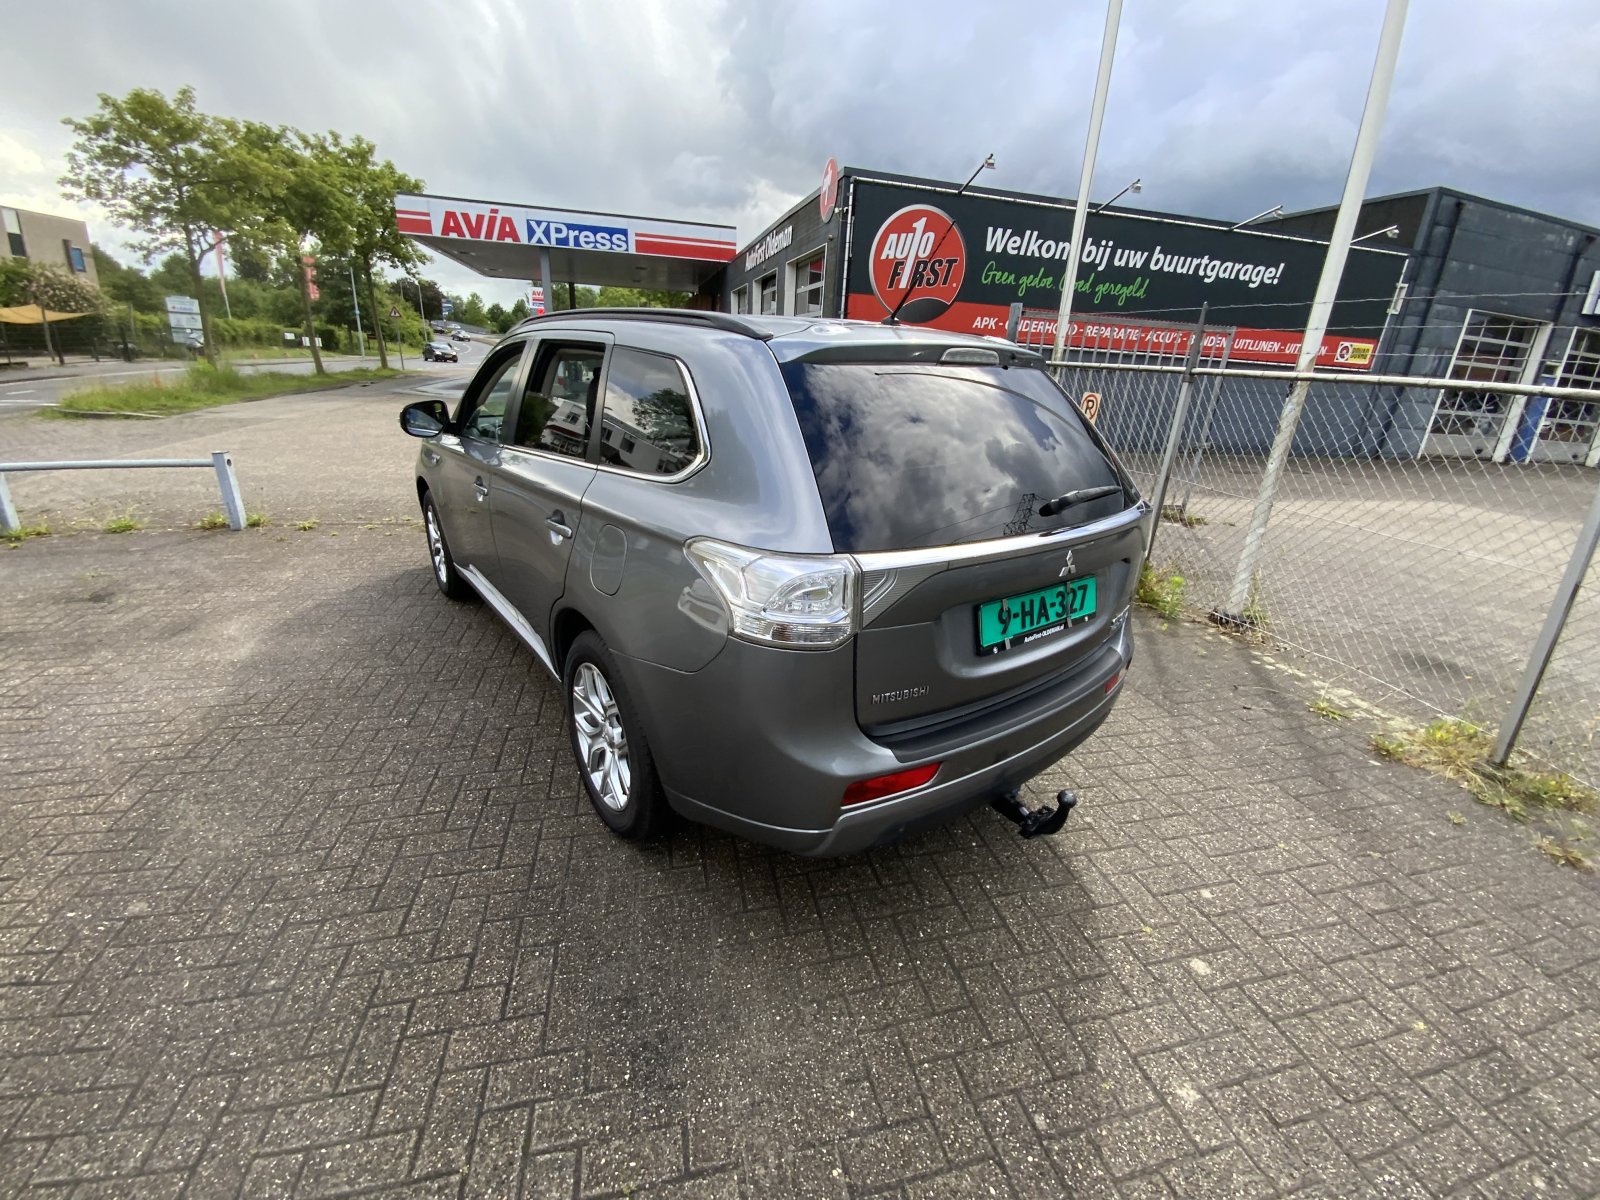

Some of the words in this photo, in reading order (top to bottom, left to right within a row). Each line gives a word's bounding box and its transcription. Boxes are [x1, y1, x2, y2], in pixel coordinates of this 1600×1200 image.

[440, 208, 521, 243] AVIA
[527, 219, 628, 252] XPress
[887, 258, 959, 290] FIRST
[1081, 237, 1114, 271] bij
[1113, 248, 1149, 269] uw
[1149, 246, 1285, 288] buurtgarage!
[981, 261, 1016, 285] Geen
[1018, 267, 1055, 296] gedoe.
[1094, 277, 1150, 306] geregeld
[972, 316, 998, 329] APK
[1004, 319, 1078, 335] DERHOD
[1085, 325, 1140, 341] REPARATIE
[1191, 334, 1227, 348] NDEN
[1234, 339, 1280, 353] UITLIJNEN
[997, 583, 1089, 635] 9-HA-327
[872, 685, 930, 704] MITSUBISHI
